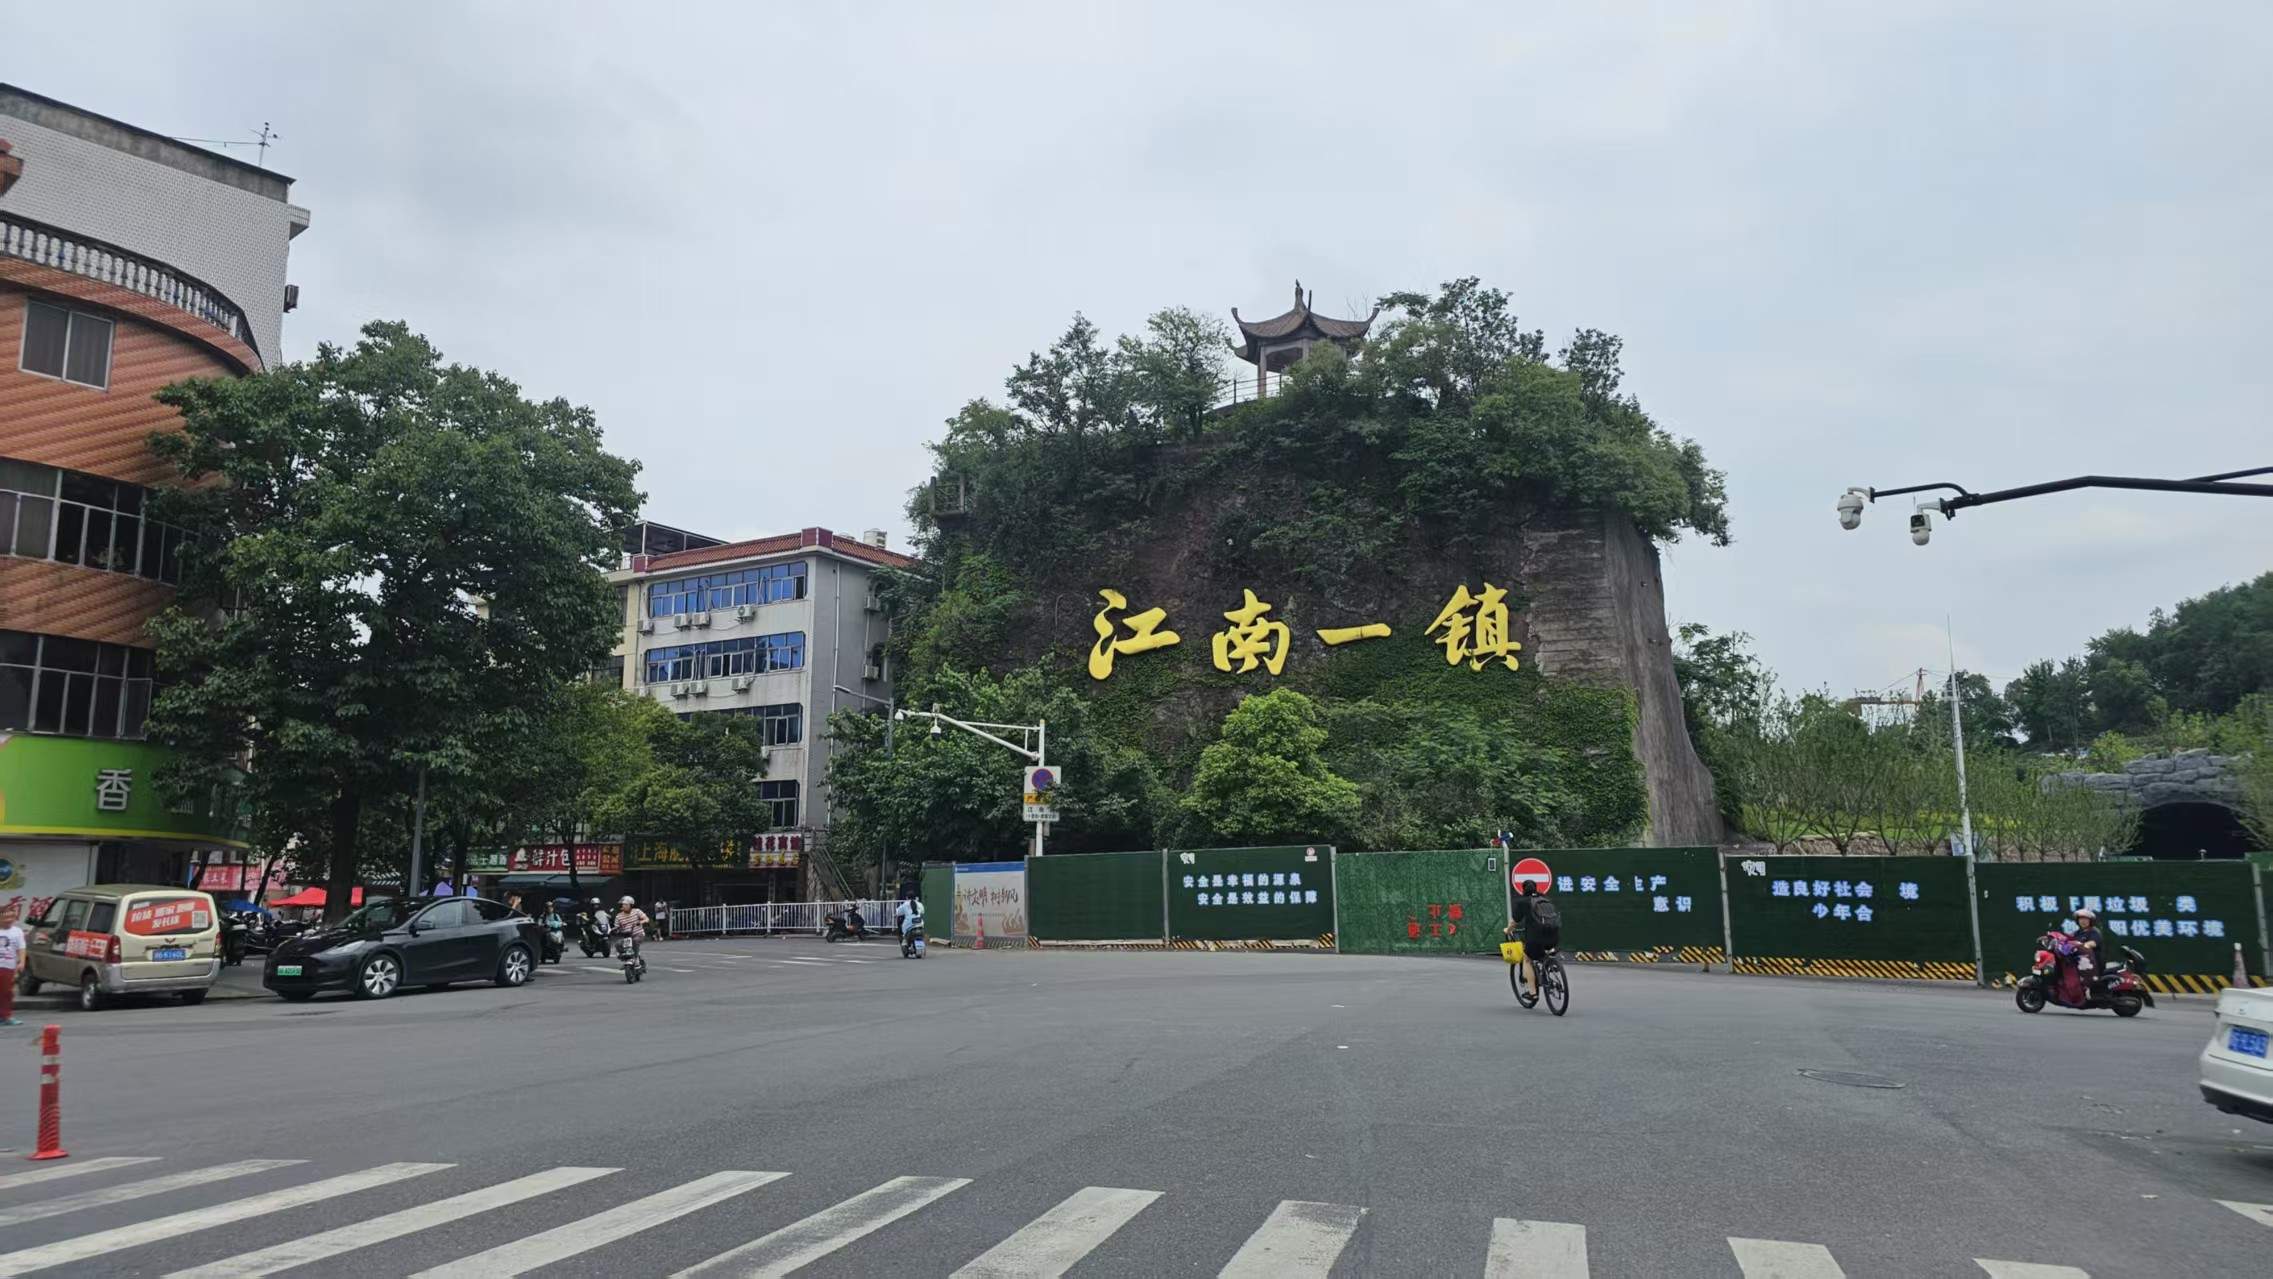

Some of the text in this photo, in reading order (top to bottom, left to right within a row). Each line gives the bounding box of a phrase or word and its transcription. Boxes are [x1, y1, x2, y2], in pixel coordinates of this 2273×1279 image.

[1088, 581, 1522, 680] 江南一镇
[96, 769, 132, 811] 香
[1183, 872, 1301, 888] 安全是幸福的源泉
[1197, 890, 1318, 906] 安全是效益的保障
[1812, 903, 1873, 921] 少年合
